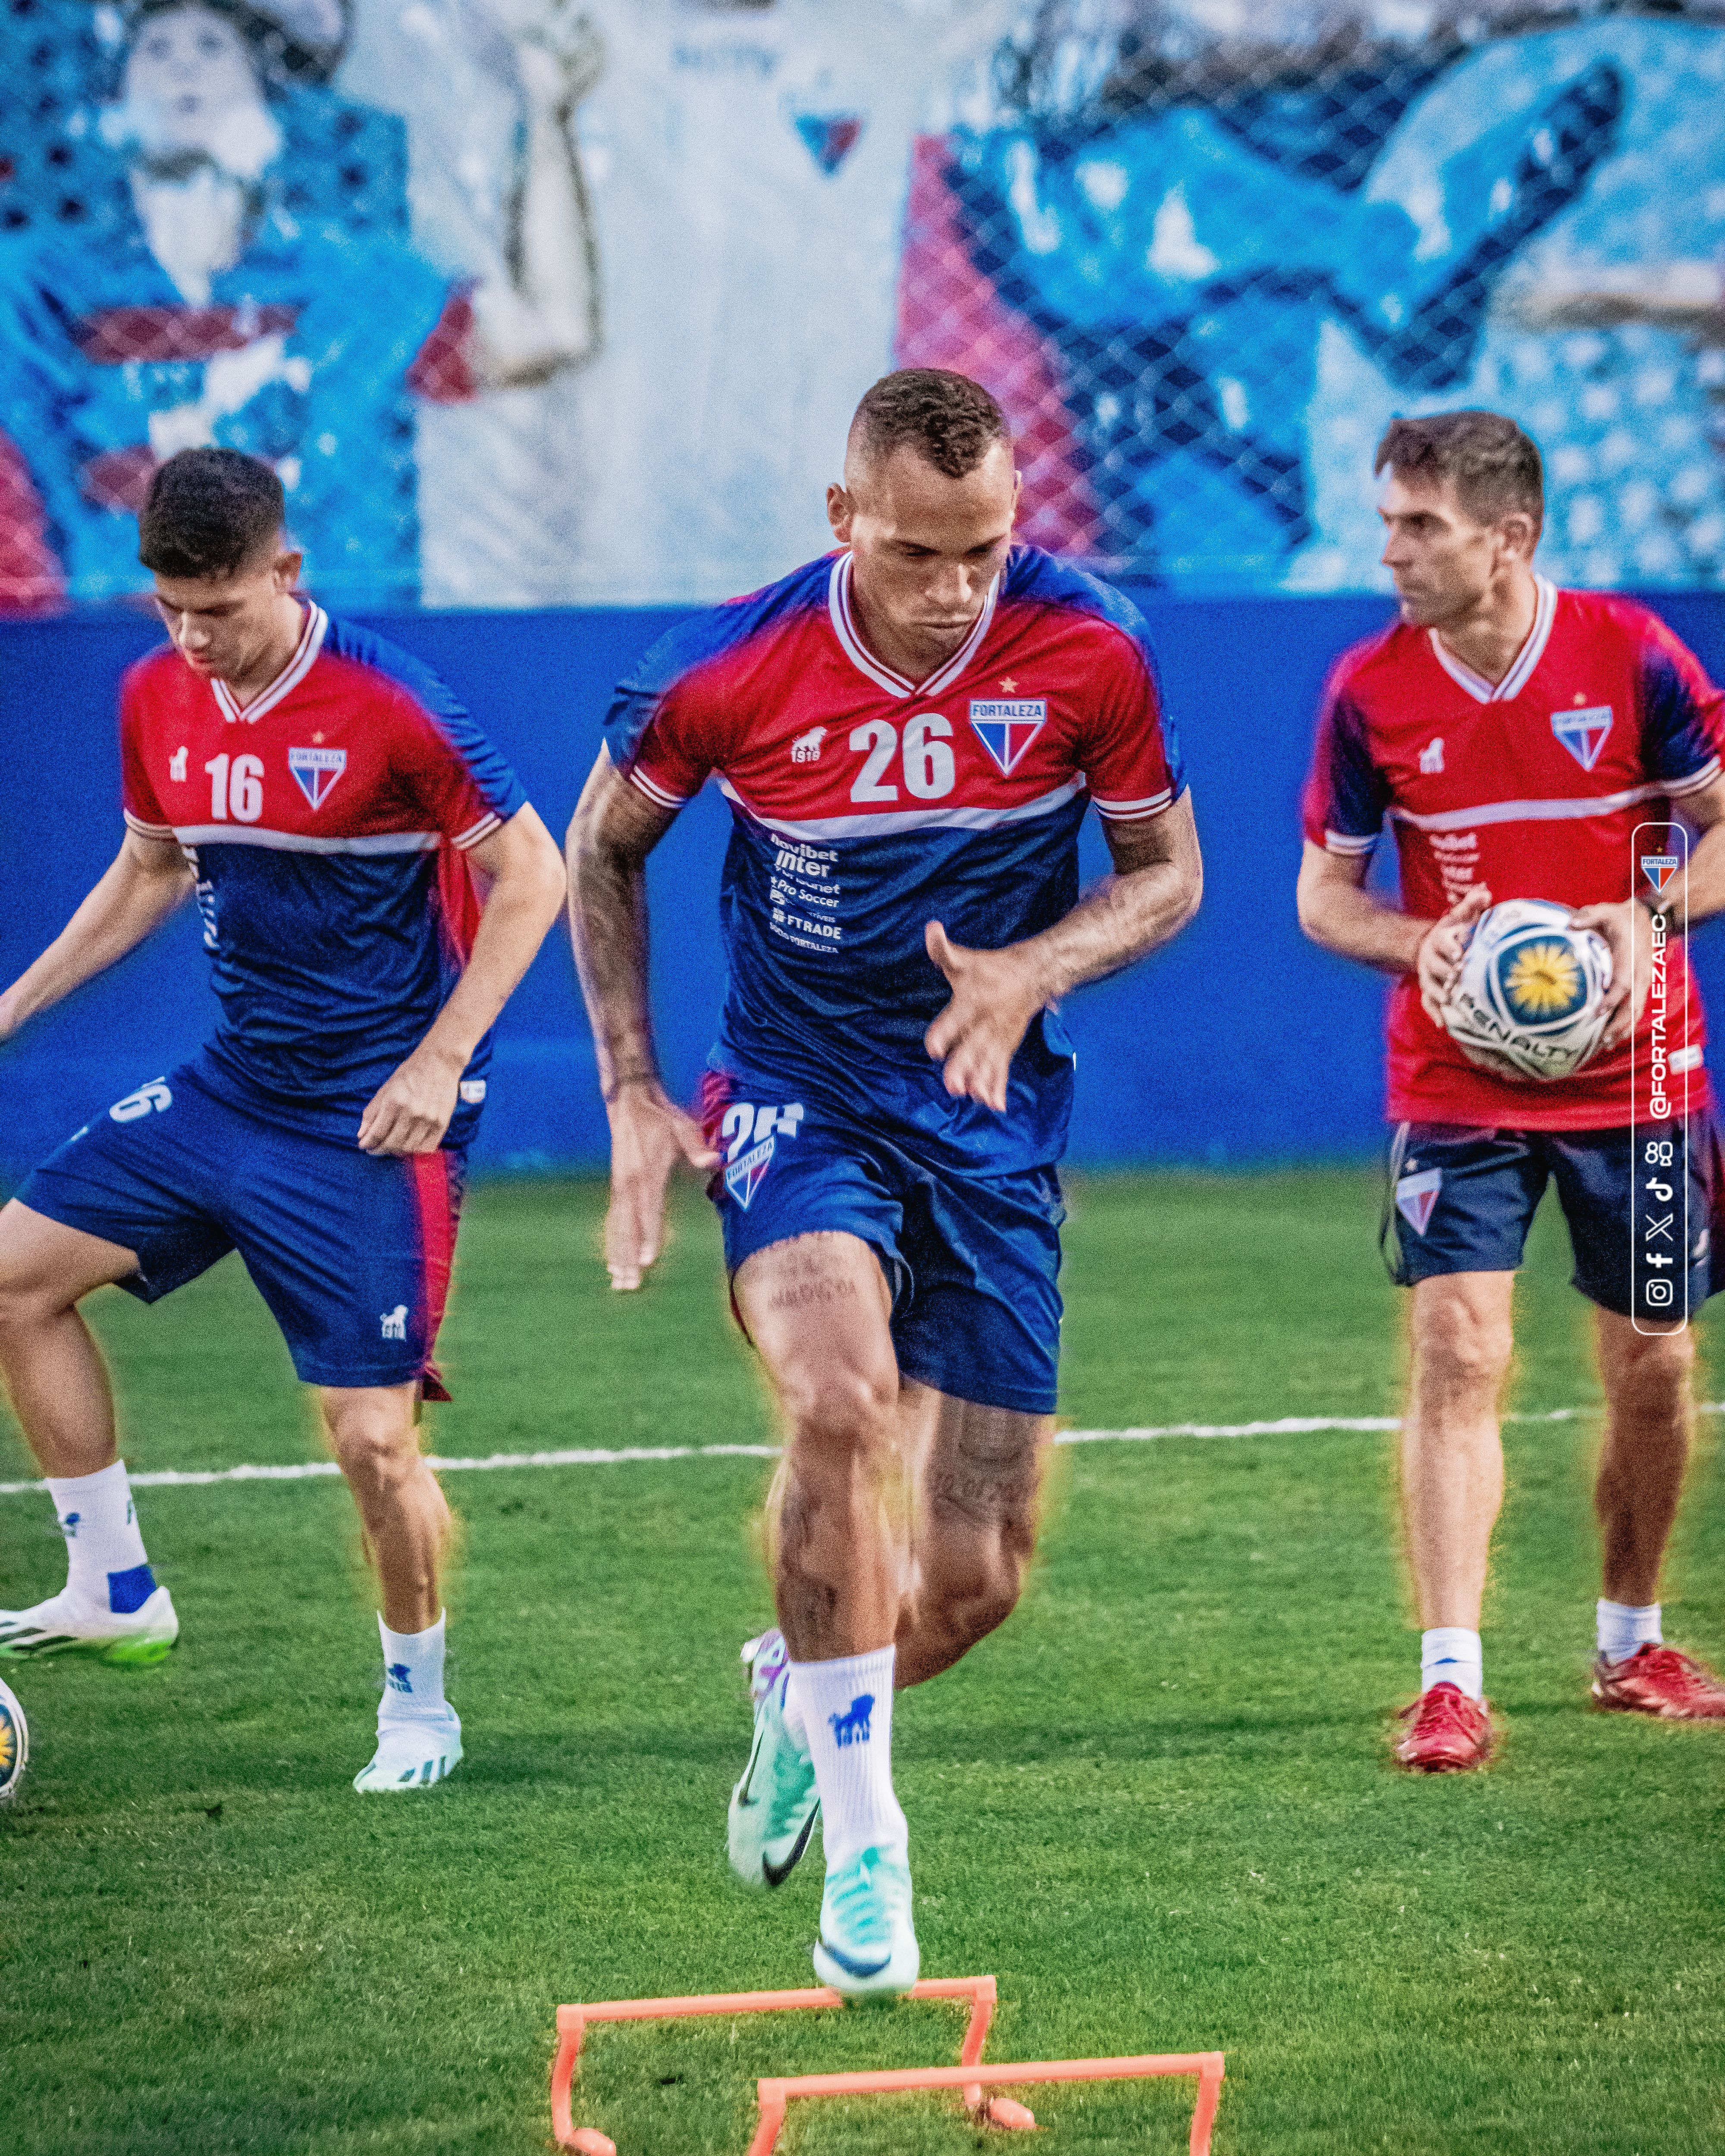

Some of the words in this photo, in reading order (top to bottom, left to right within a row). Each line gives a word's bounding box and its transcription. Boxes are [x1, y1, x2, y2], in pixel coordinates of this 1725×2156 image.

[972, 704, 1041, 717] FORTALEZA
[849, 713, 956, 802] 26
[204, 753, 265, 822] 16
[778, 880, 797, 895] Pro
[798, 889, 840, 908] Soccer
[787, 914, 842, 940] FTRADE
